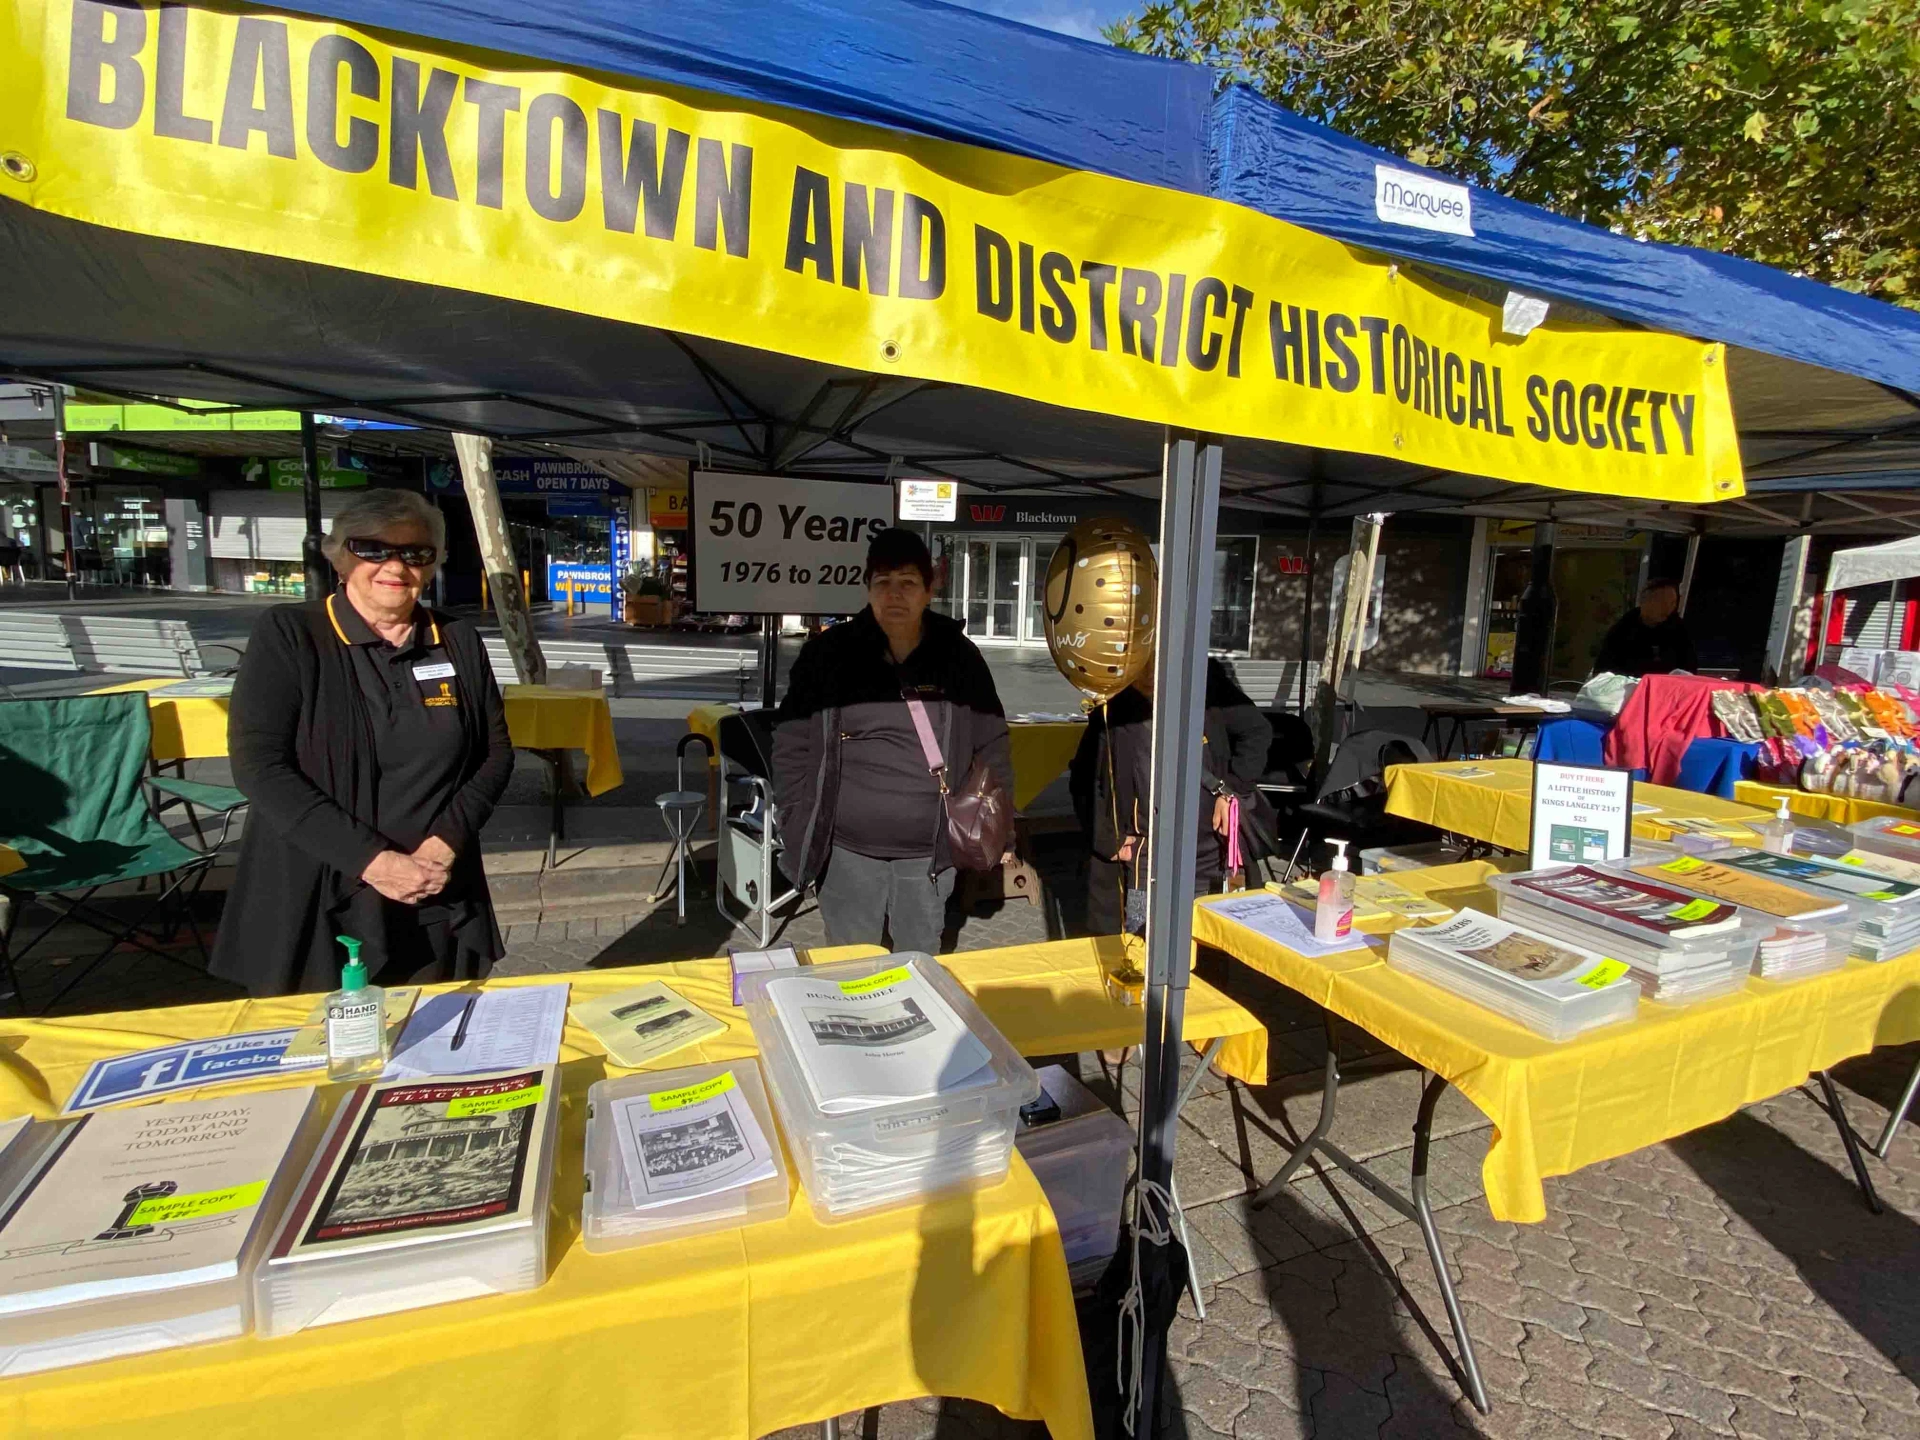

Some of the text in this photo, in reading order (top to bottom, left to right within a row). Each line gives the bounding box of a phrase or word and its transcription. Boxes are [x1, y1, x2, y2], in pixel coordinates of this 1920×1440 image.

[66, 0, 1696, 456] BLACKTOWN AND DISTRICT HISTORICAL SOCIETY
[536, 477, 568, 490] OPEN
[571, 478, 577, 489] 7
[580, 478, 610, 490] DAYS
[708, 500, 763, 539] 50
[777, 503, 888, 543] Years
[1015, 511, 1077, 525] Blacktown
[720, 560, 782, 584] 1976
[788, 564, 812, 585] to
[1585, 776, 1605, 784] HERE
[1554, 785, 1581, 794] LITTLE
[1582, 788, 1616, 798] HISTORY
[1541, 798, 1621, 813] KINGS LANGLEY 2147
[873, 974, 894, 985] COPY
[805, 986, 897, 1002] BUNGARRIBEE
[345, 1004, 377, 1015] HAND
[225, 1038, 292, 1051] Like us
[388, 1083, 527, 1103] BLACKTOWN
[660, 1079, 724, 1102] SAMPLE COPY
[460, 1091, 533, 1110] SAMPLE COPY
[134, 1118, 249, 1139] TODAY AND
[124, 1128, 248, 1151] TOMORROW
[138, 1192, 238, 1215] SAMPLE COPY
